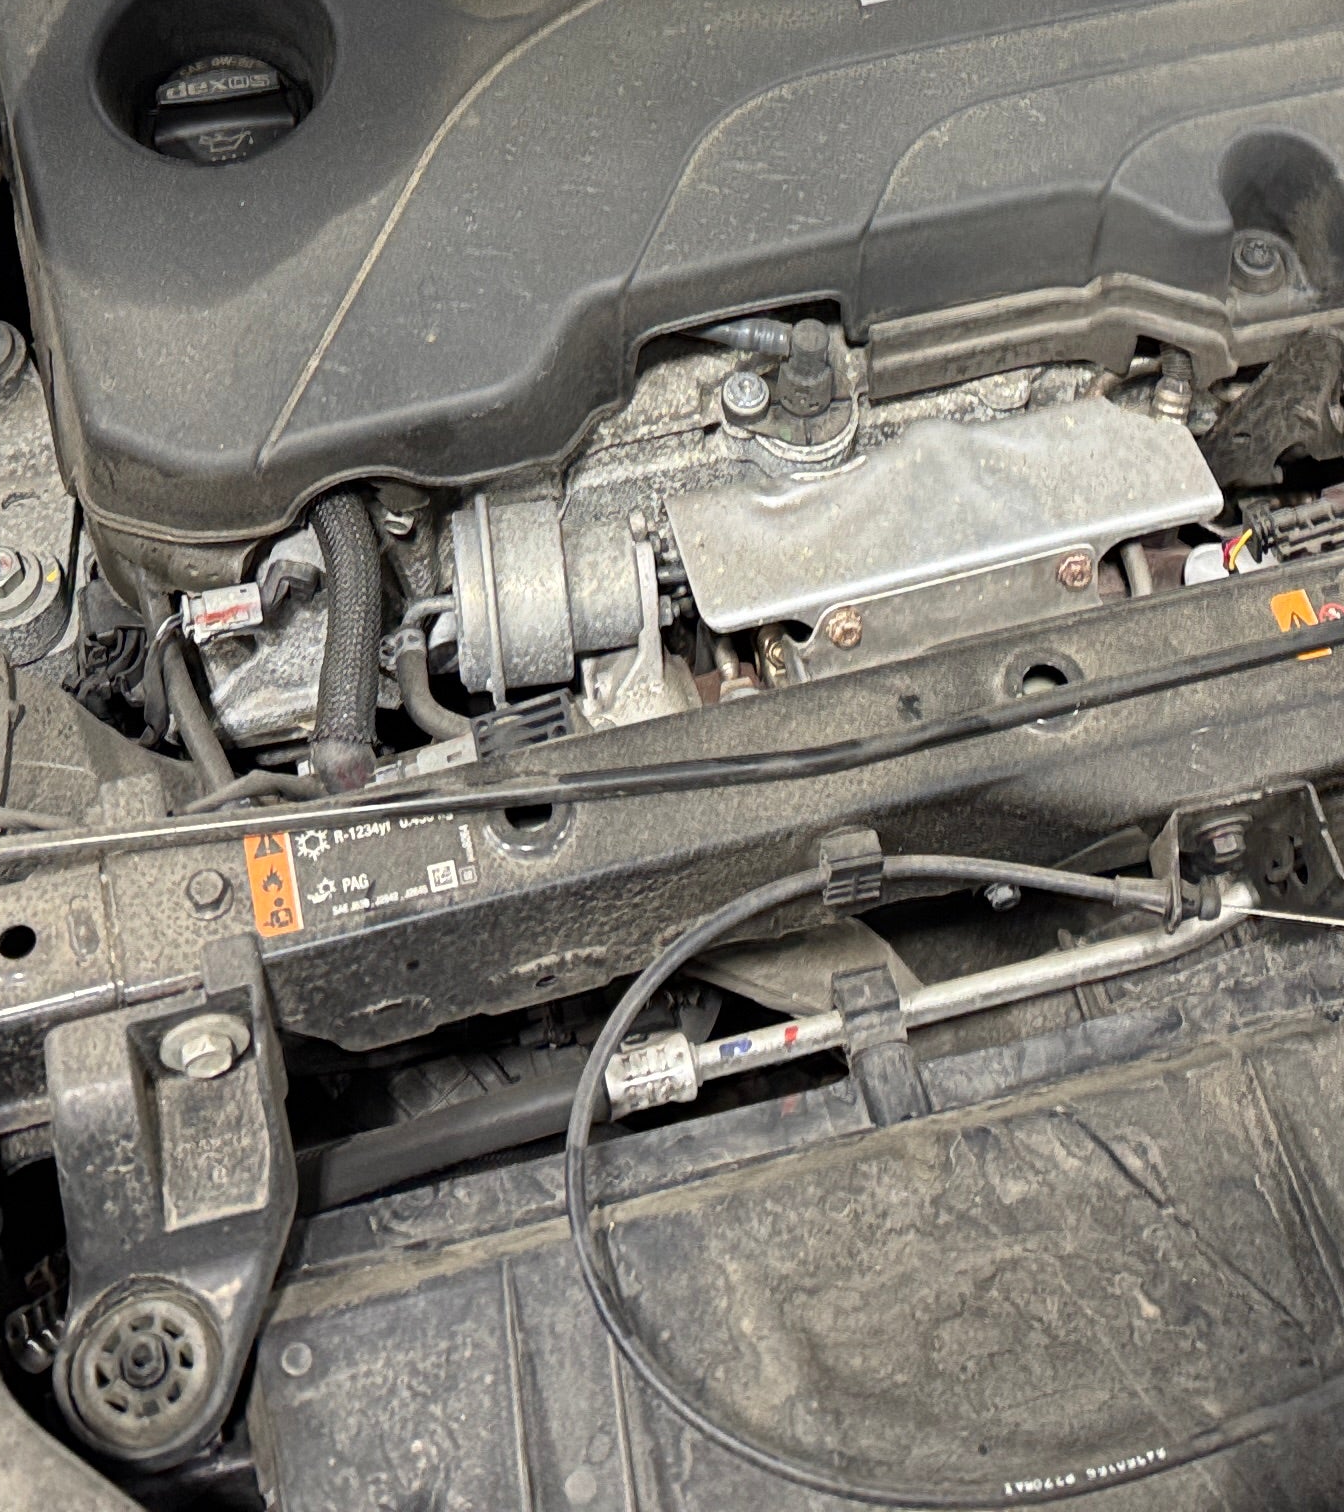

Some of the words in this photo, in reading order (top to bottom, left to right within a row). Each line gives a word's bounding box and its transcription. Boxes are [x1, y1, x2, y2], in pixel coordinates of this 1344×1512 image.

[166, 74, 270, 99] dexos
[333, 820, 391, 845] R-1234yf
[342, 872, 370, 893] PAG
